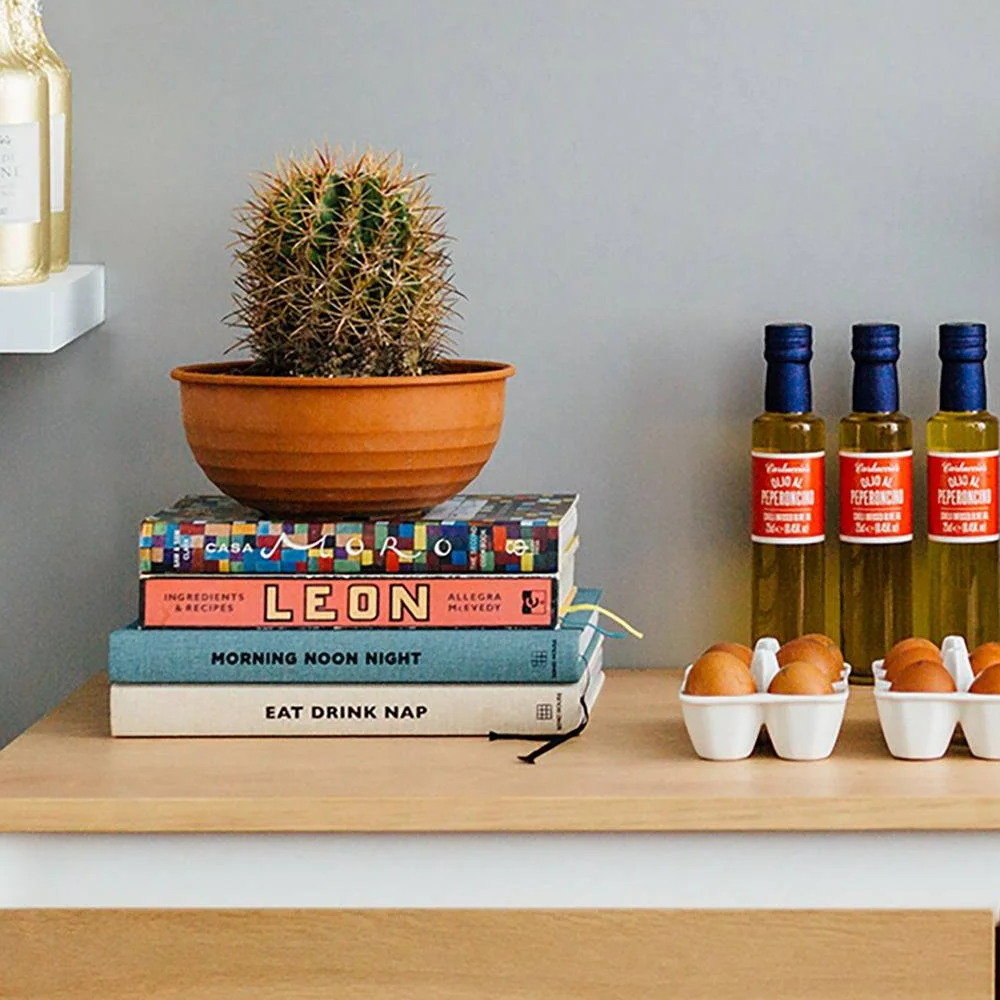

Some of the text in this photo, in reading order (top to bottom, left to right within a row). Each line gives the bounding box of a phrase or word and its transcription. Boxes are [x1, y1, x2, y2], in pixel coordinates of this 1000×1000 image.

[205, 542, 254, 553] CASA
[260, 532, 451, 559] MORO
[164, 592, 245, 601] INGREDIENTS
[447, 593, 502, 601] ALLEGRA
[175, 603, 234, 612] & RECIPES
[263, 583, 430, 622] LEON
[448, 604, 501, 612] McEVEDY
[211, 651, 422, 666] MORNING NOON NIGHT
[265, 705, 429, 720] EAT DRINK NAP
